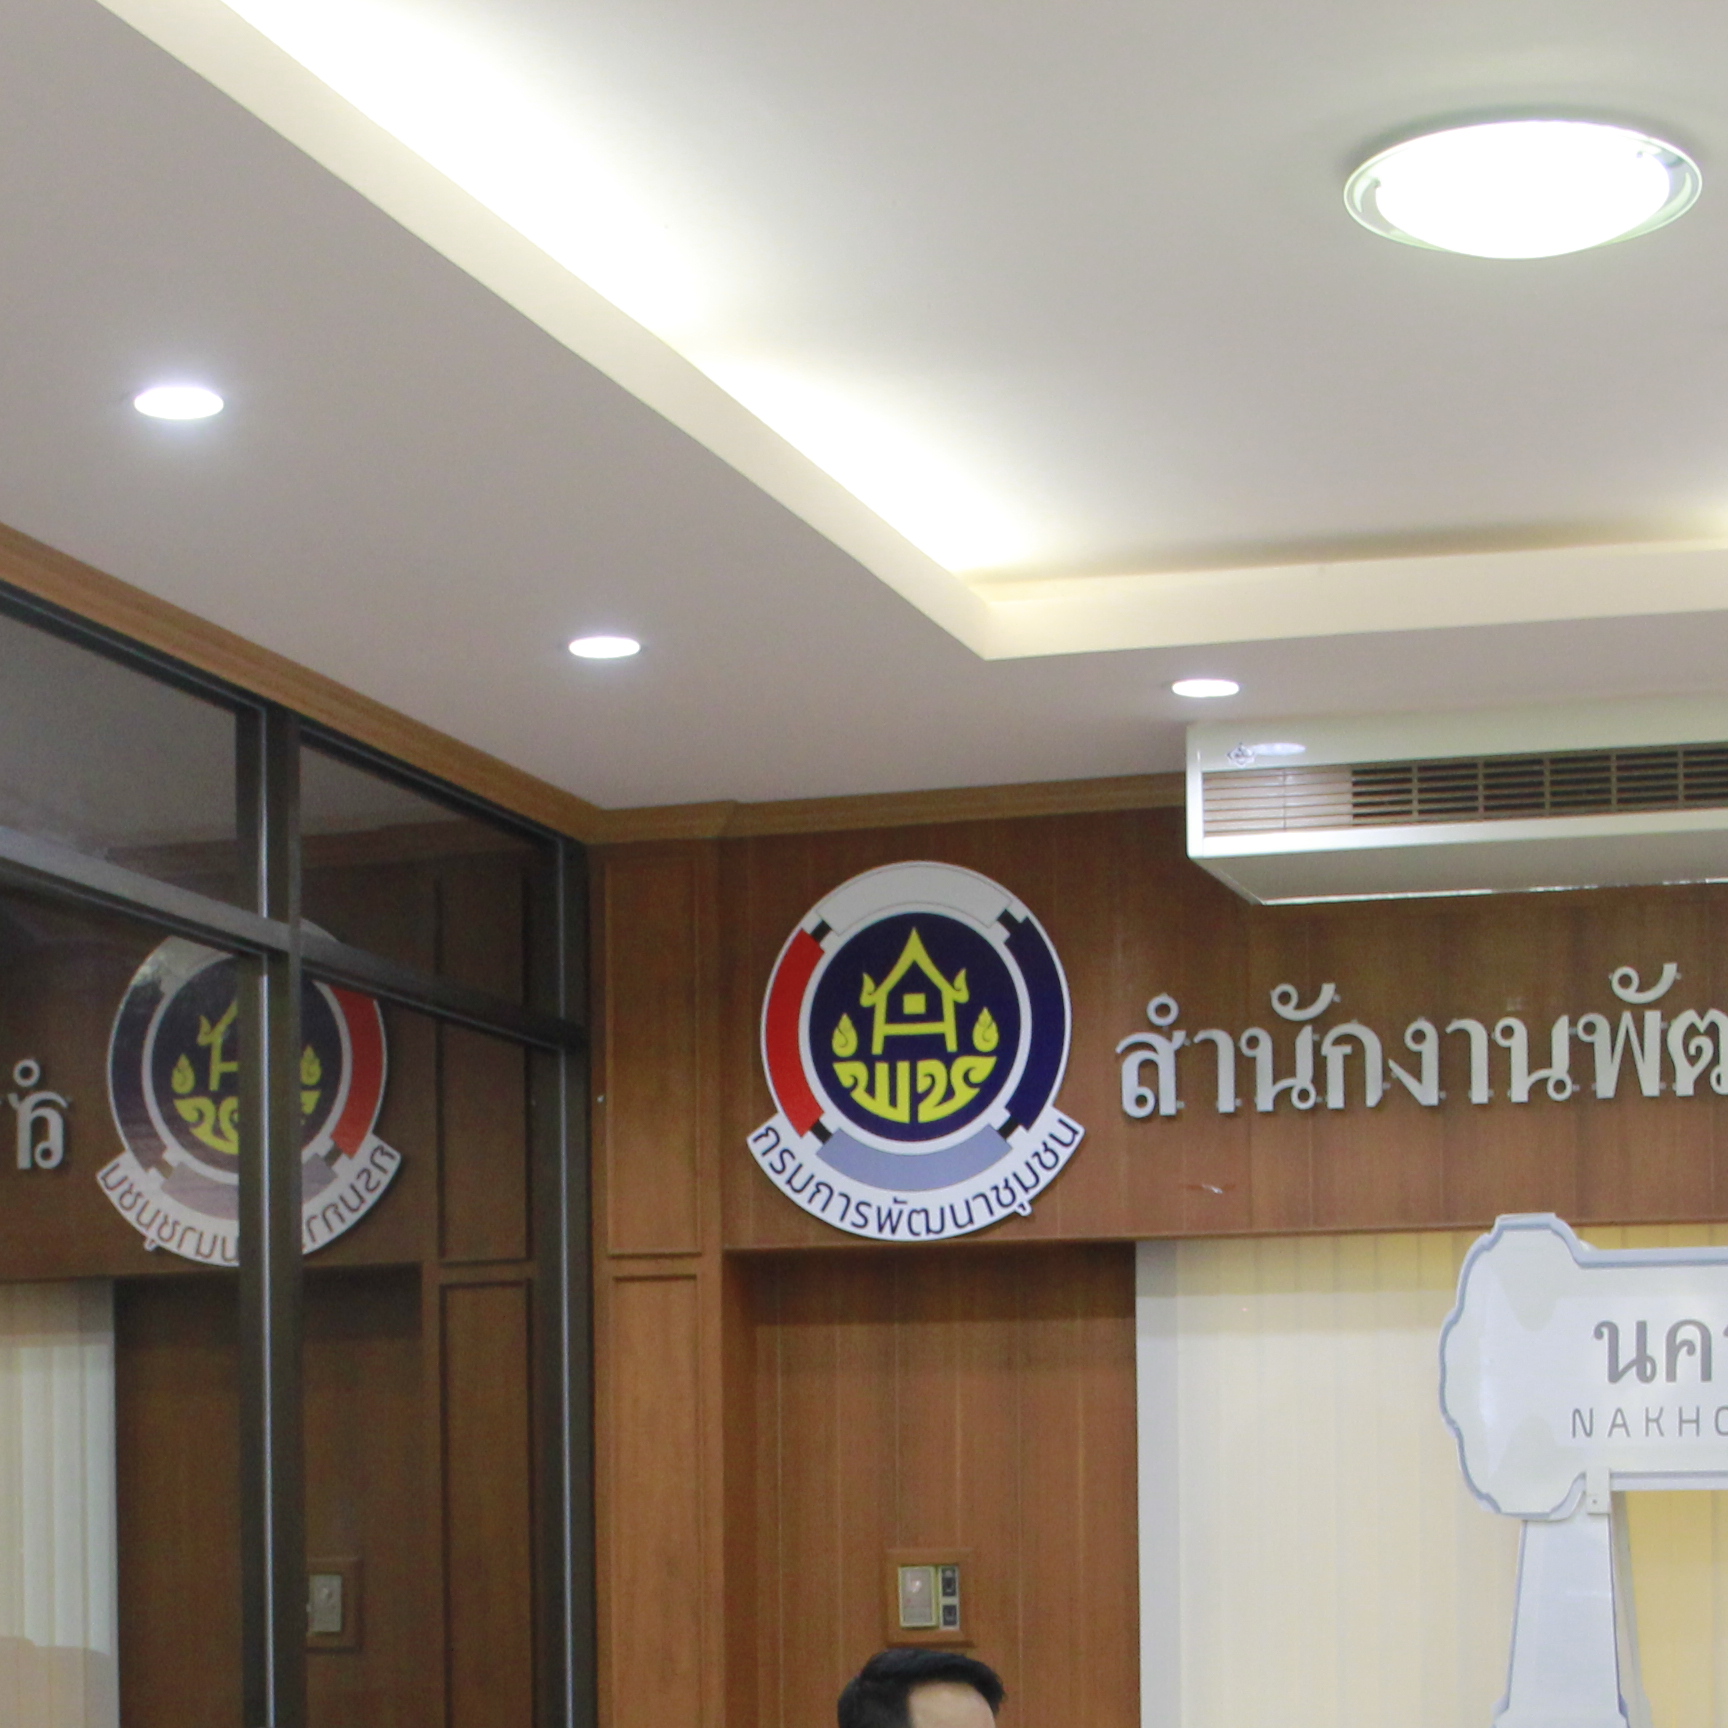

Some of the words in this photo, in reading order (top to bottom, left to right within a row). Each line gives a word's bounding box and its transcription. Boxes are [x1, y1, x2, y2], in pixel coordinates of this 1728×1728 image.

[751, 1117, 1080, 1238] กรมการพัฒนาชุมชน
